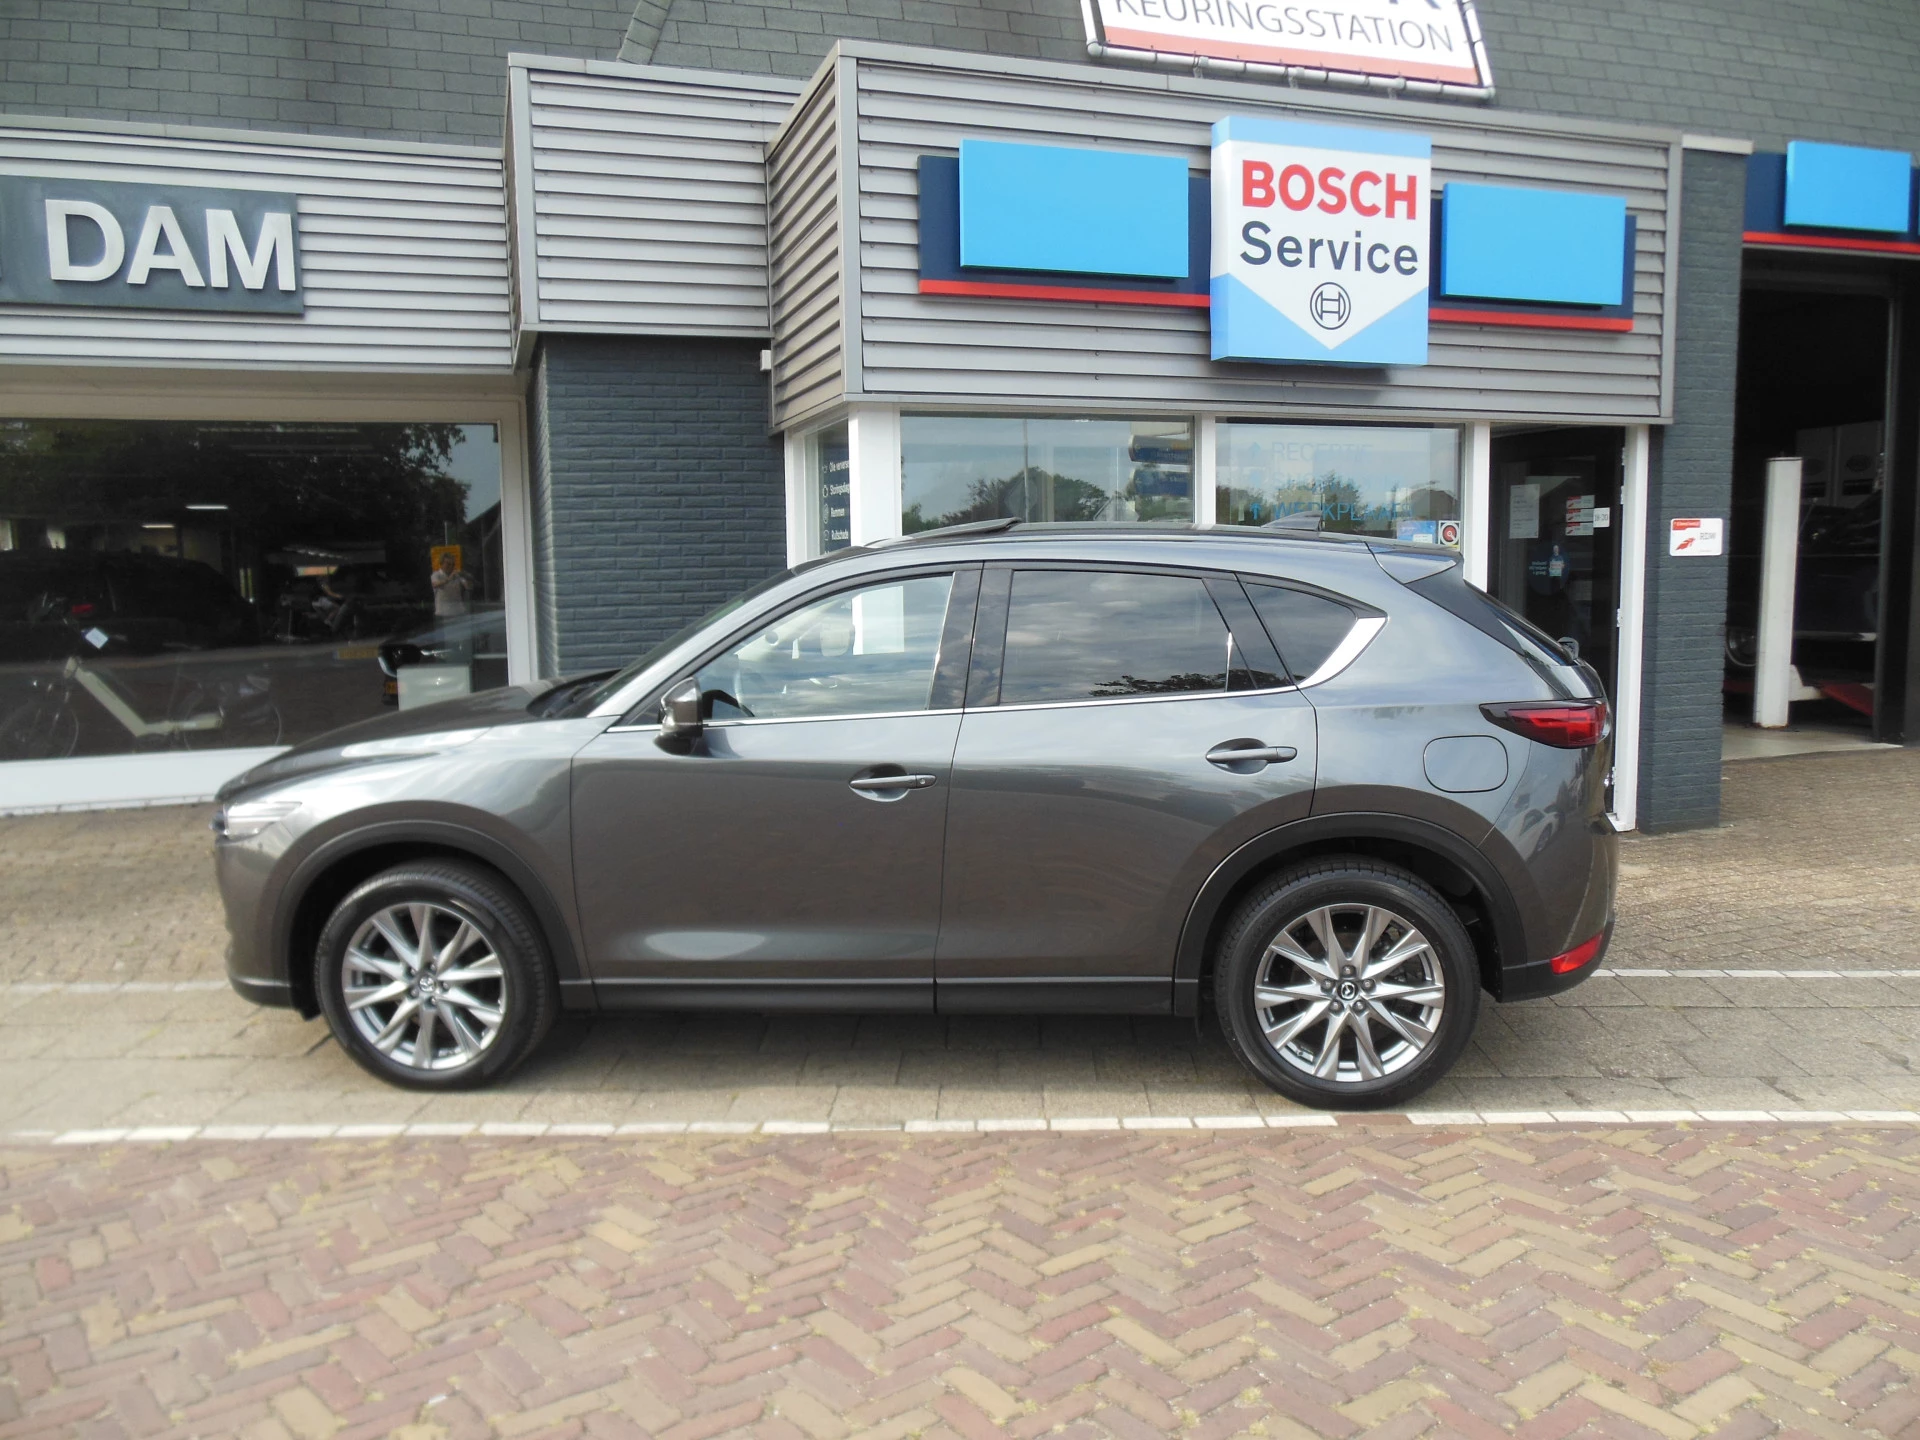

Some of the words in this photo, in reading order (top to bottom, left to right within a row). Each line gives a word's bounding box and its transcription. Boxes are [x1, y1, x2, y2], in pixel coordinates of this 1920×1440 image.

[1117, 0, 1454, 53] KEURINGSSTATION
[1242, 159, 1418, 221] BOSCH
[45, 199, 297, 291] DAM
[1240, 220, 1419, 277] Service
